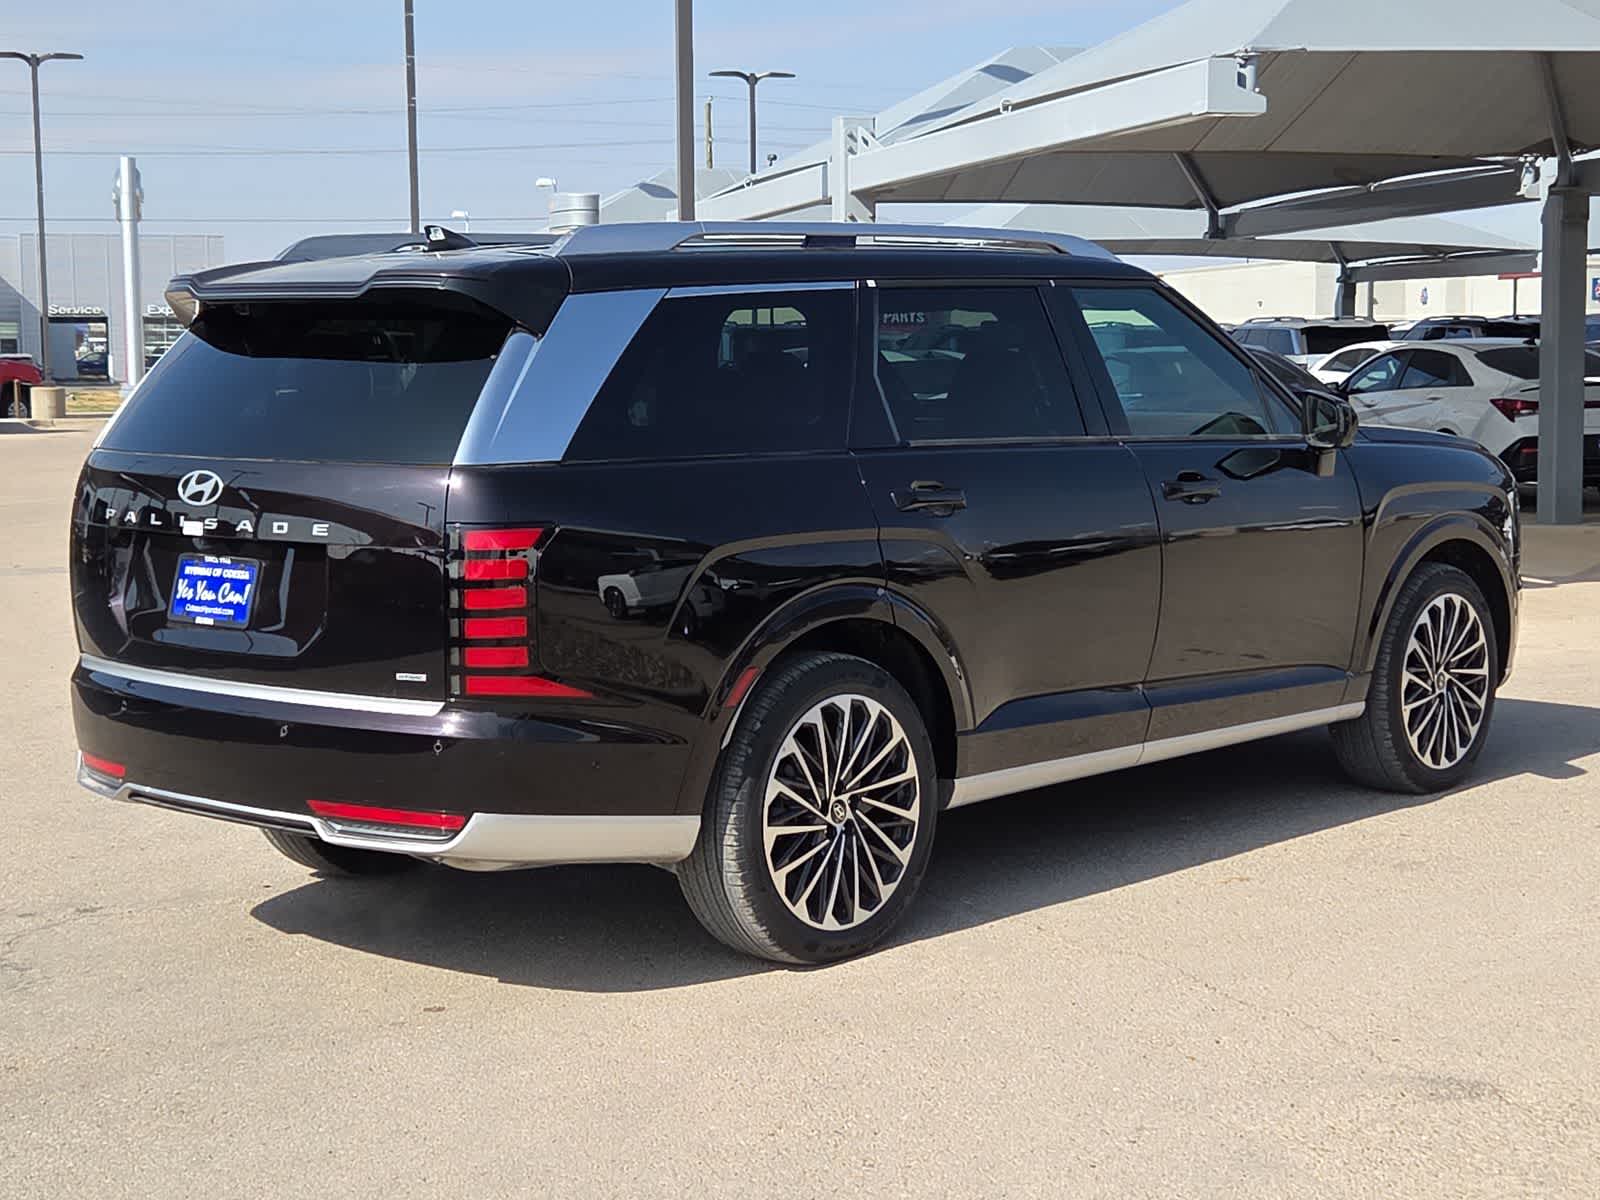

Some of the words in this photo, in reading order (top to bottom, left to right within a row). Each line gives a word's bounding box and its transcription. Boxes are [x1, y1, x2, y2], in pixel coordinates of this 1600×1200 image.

[48, 303, 103, 315] Service
[882, 311, 926, 324] PARTS
[105, 508, 331, 537] PALISADE
[175, 579, 195, 600] Yes
[195, 580, 217, 601] You
[217, 582, 252, 605] Can!
